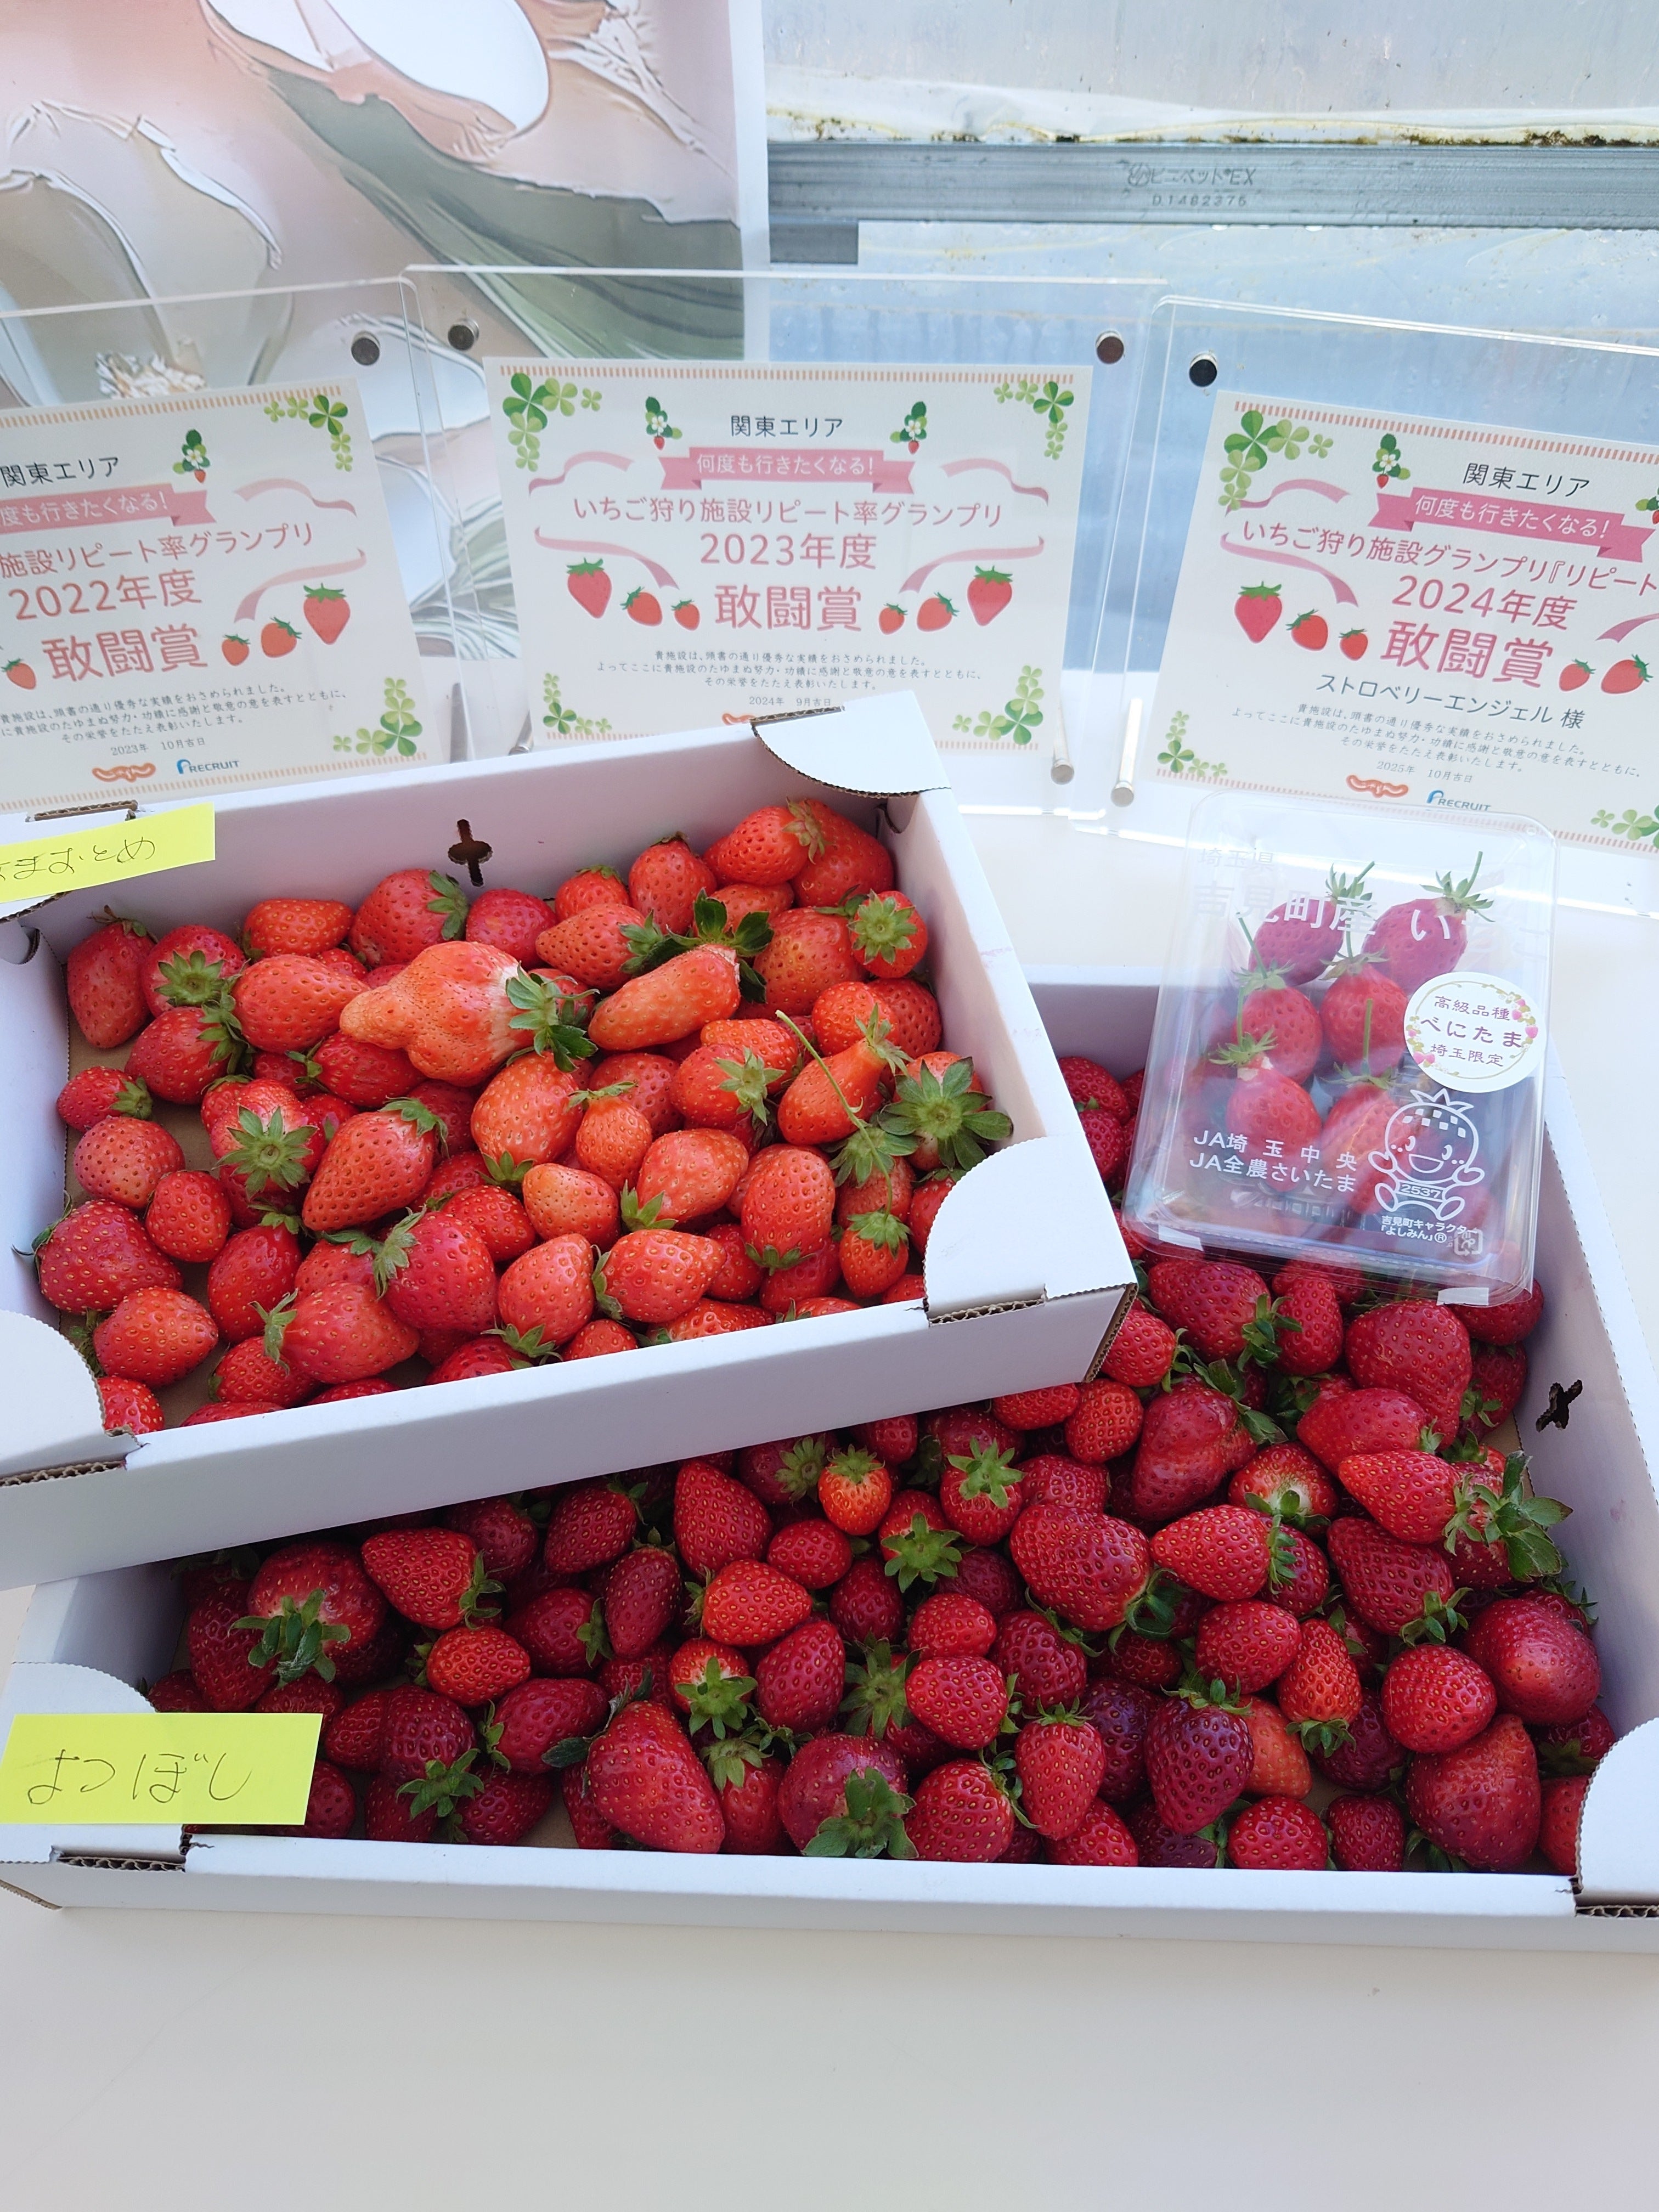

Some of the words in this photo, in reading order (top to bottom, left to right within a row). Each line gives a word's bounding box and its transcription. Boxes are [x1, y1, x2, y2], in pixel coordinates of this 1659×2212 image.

[730, 415, 844, 438] 関東エリア
[1, 457, 119, 488] 関東エリア
[1462, 462, 1589, 497] 関東エリア
[573, 496, 1003, 528] いちご狩り施設リピート率グランプリ
[0, 523, 313, 578] 施設リピート率グランプリ
[699, 532, 877, 571] 2023年度
[1243, 519, 1657, 596] いちご狩り施設グランプリ『リピート
[8, 568, 202, 621] 2022年度
[714, 583, 863, 633] 敢闘賞
[1392, 575, 1577, 631] 2024年度
[42, 623, 208, 682] 敢闘賞
[1380, 620, 1554, 689] 敢闘賞
[749, 696, 785, 706] 2024年
[796, 698, 832, 707] 9月吉日
[1316, 674, 1553, 723] ストロベリーエンジェル
[1560, 708, 1585, 729] 様
[111, 743, 149, 756] 2023年
[161, 737, 206, 751] 10月吉日
[189, 760, 240, 773] RECRUIT
[1376, 761, 1415, 775] 2025年
[1427, 769, 1473, 783] 10月吉日
[1437, 798, 1491, 811] RECRUIT
[1198, 848, 1276, 872] 埼玉県
[1193, 878, 1376, 936] 吉見町産
[1434, 996, 1510, 1021] 高級品種
[1420, 1017, 1522, 1048] べにたま
[1430, 1043, 1504, 1067] 埼玉限定
[1189, 1152, 1357, 1193] JA全農さいたま
[1401, 1184, 1441, 1198] 2537
[1381, 1215, 1478, 1234] 吉見町キャラクター
[28, 1749, 253, 1805] よつぼし
